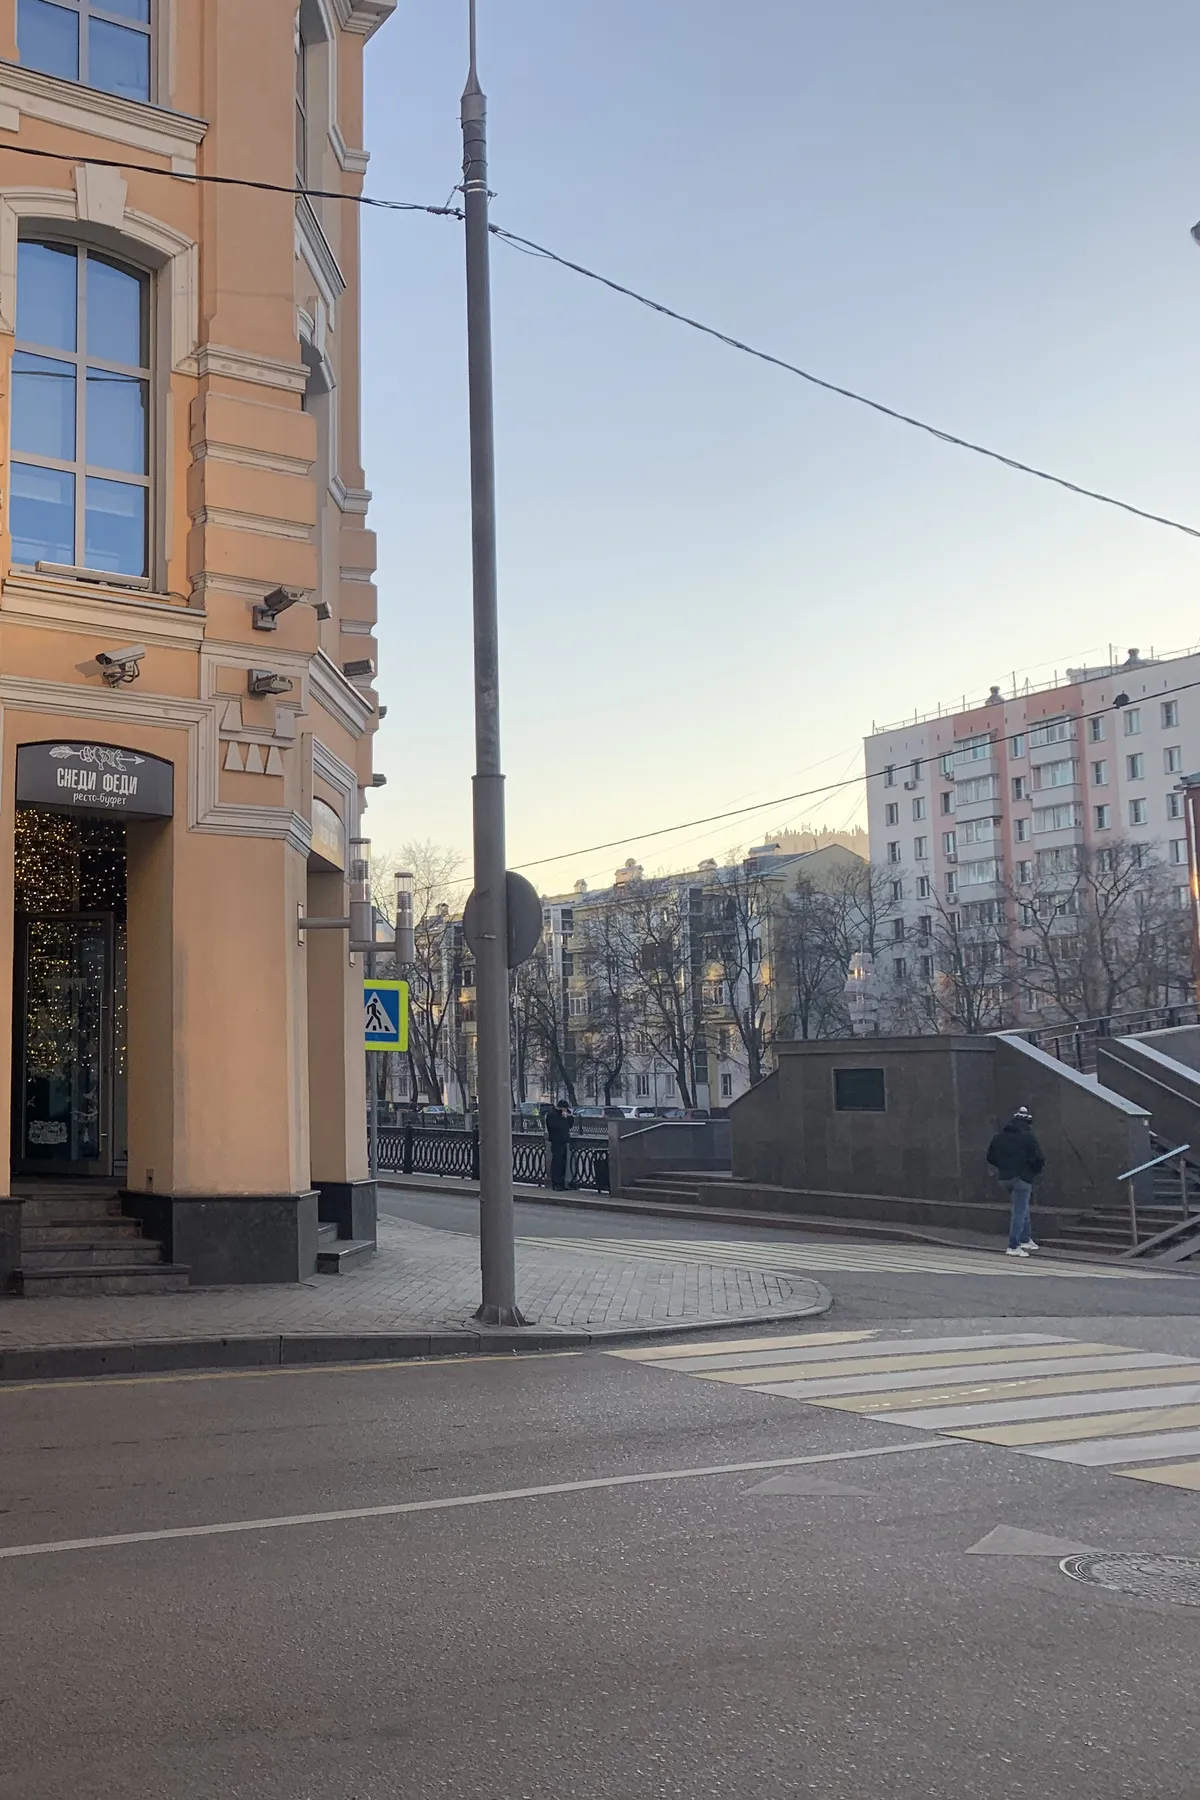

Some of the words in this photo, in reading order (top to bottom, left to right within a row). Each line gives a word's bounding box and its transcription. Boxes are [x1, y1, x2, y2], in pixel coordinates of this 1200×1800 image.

[56, 767, 97, 791] СНЕДИ
[102, 773, 138, 795] ФЕДИ
[73, 792, 127, 807] ресто-буфет
